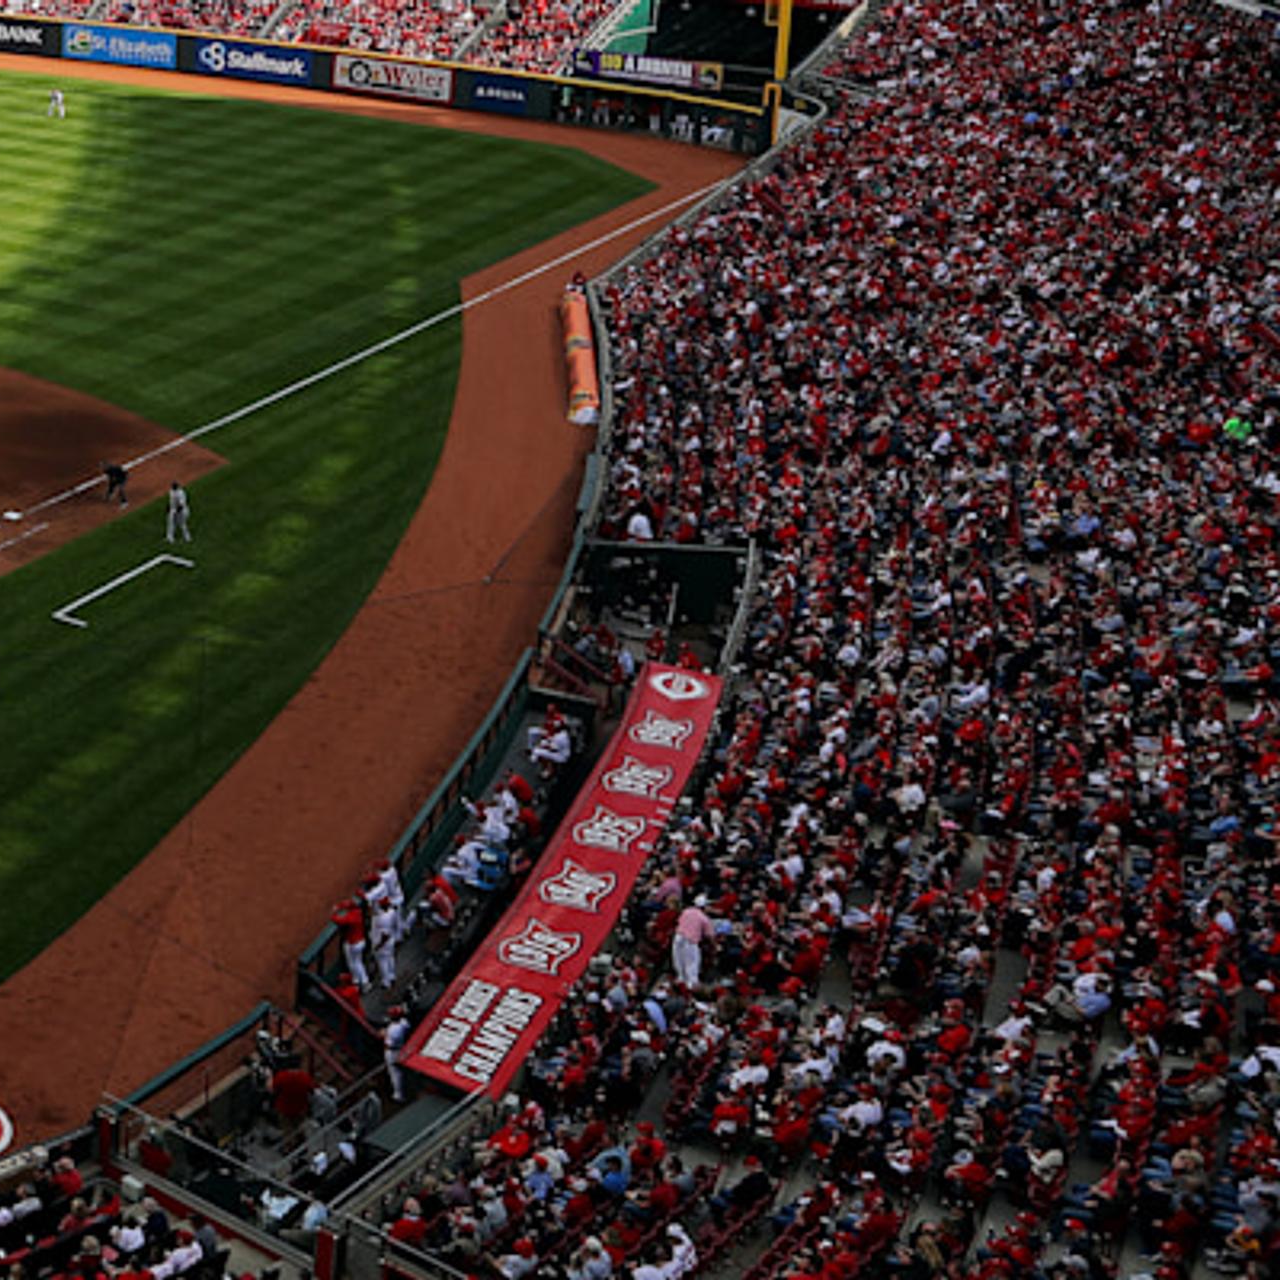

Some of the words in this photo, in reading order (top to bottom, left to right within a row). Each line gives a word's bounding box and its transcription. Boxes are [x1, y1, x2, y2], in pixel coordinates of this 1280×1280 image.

[226, 50, 307, 77] Staffmark
[382, 64, 445, 88] Wyler
[454, 988, 542, 1083] CHAMPIONS
